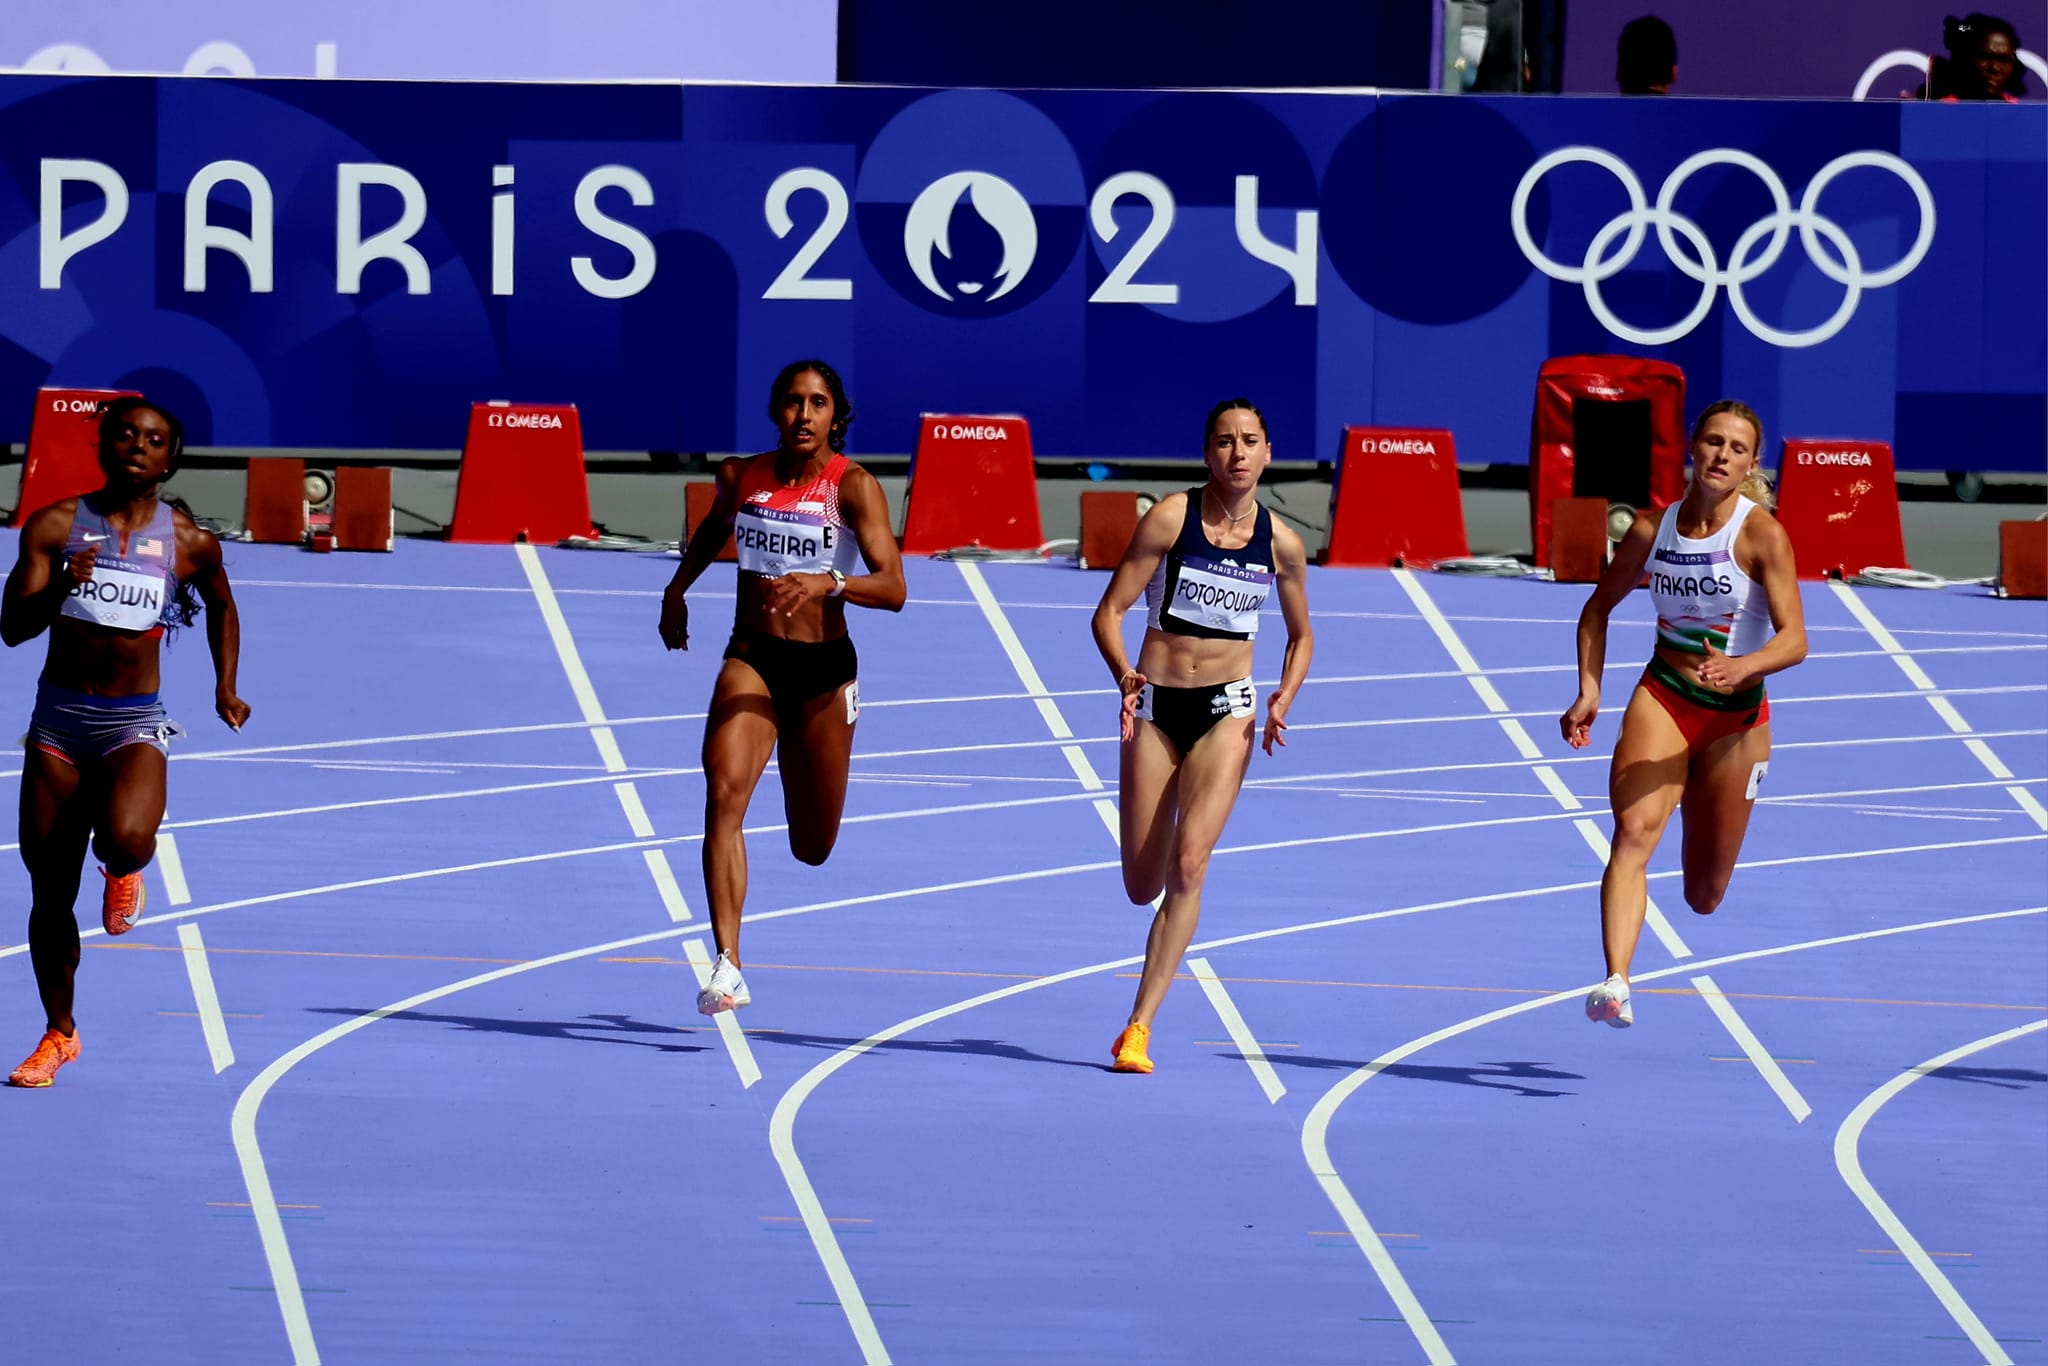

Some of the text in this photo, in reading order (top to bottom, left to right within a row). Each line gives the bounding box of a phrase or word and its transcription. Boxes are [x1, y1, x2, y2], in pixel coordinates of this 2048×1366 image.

[761, 167, 1319, 305] 2024
[505, 413, 562, 429] OMEGA
[950, 425, 1007, 440] OMEGA
[1378, 438, 1436, 455] OMEGA
[1815, 451, 1872, 466] OMEGA
[778, 513, 799, 521] 2024
[736, 525, 817, 558] PEREIRA
[823, 526, 833, 549] E
[95, 557, 117, 567] ARIS
[1207, 563, 1256, 579] PARIS 2024
[1654, 572, 1732, 597] TAKACS
[1177, 579, 1266, 612] FOTOPOULOU
[1240, 686, 1253, 708] 5
